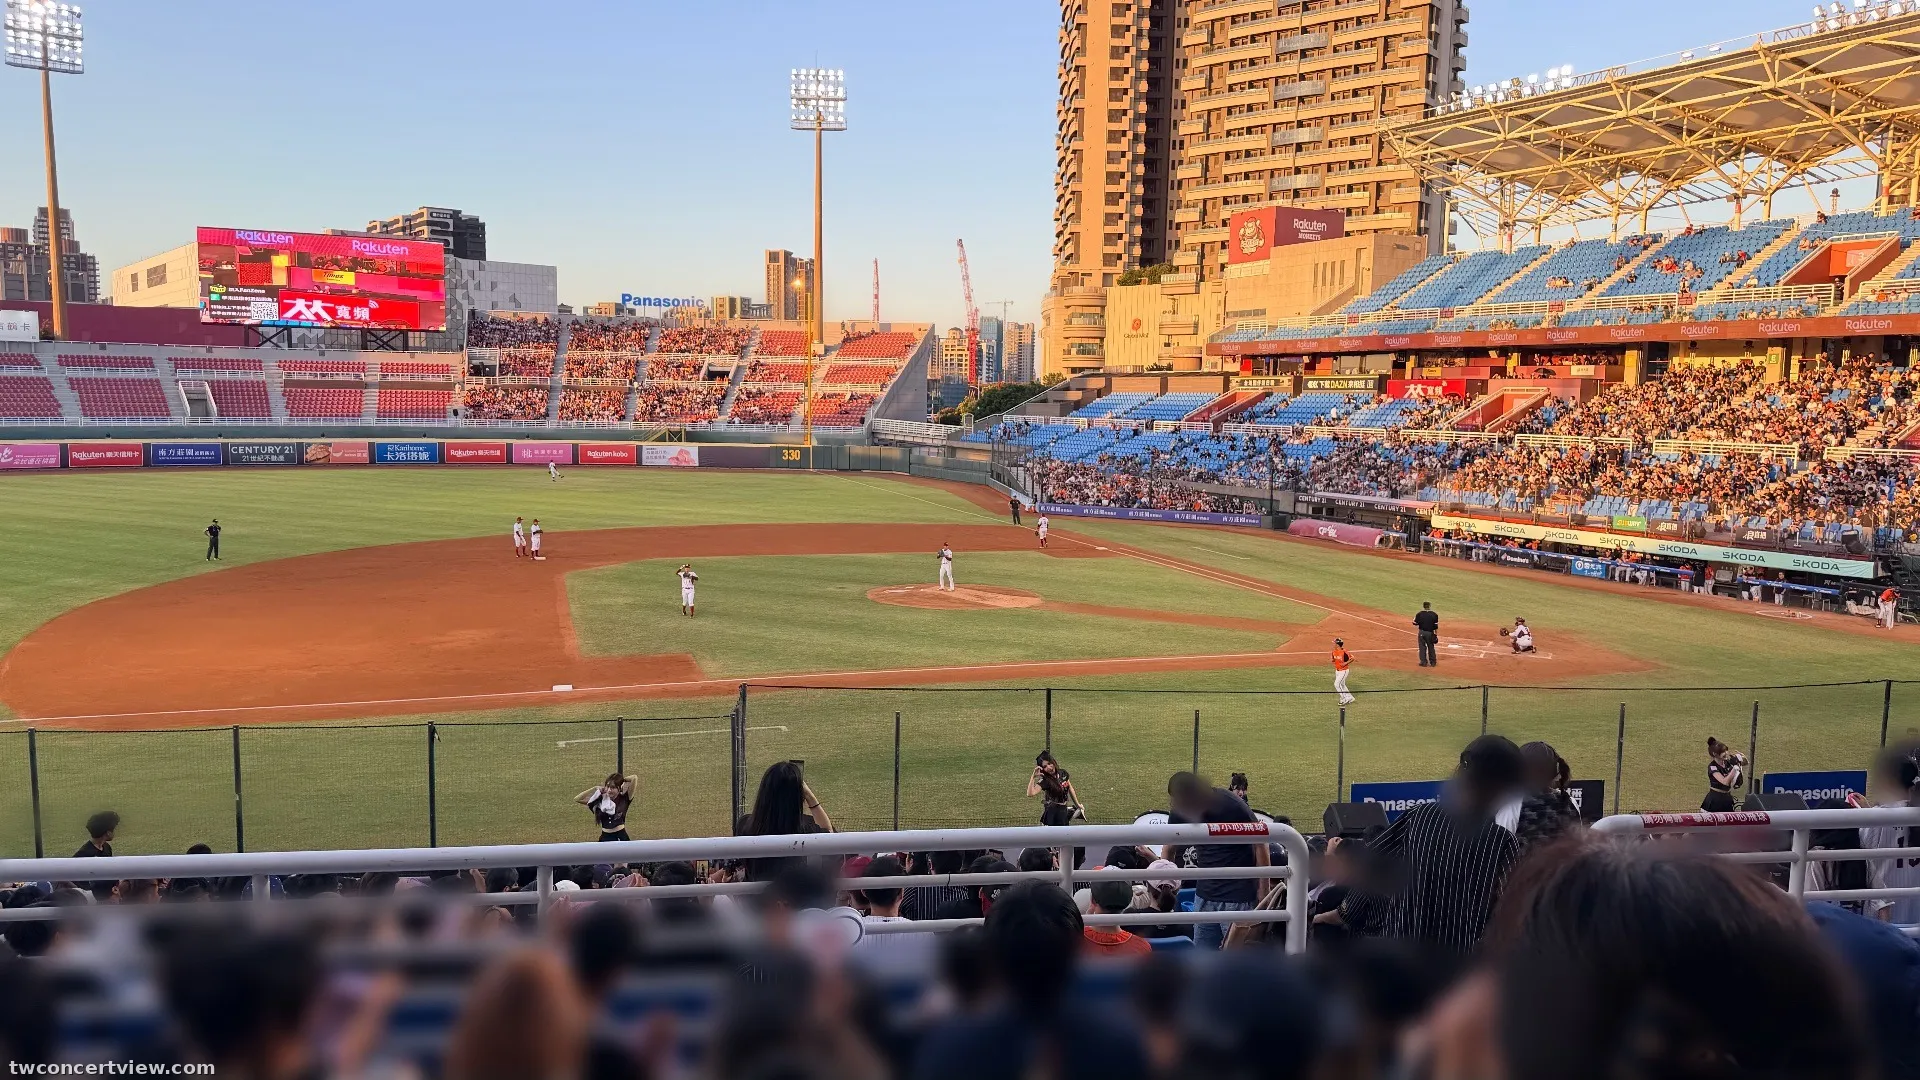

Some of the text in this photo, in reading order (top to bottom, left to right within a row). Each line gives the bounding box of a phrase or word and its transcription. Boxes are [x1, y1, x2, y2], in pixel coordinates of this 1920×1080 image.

[1293, 218, 1327, 233] Rakuten
[235, 230, 294, 244] Rakuten
[352, 240, 408, 256] Rakuten
[621, 293, 705, 308] Panasonic
[1680, 325, 1719, 338] Rakuten
[1758, 321, 1800, 335] Rakuten
[1845, 319, 1892, 333] Rakuten
[1488, 332, 1518, 344] Rakuten
[1546, 330, 1579, 342] Rakuten
[1610, 327, 1645, 340] Rakuten
[1296, 341, 1318, 350] Rakuten
[1339, 338, 1362, 349] Rakuten
[1384, 336, 1410, 347] Rakuten
[1434, 334, 1461, 346] Rakuten
[72, 450, 106, 460] Rakuten
[231, 445, 295, 454] CENTURY 21
[450, 449, 478, 458] Rakuten
[587, 450, 613, 459] Rakuten
[782, 449, 801, 461] 330
[1298, 495, 1321, 503] CENTURY
[1335, 499, 1359, 507] CENTURY
[1374, 503, 1400, 512] CENTURY
[1617, 519, 1642, 528] SUBWAY
[1506, 555, 1529, 564] Domino's
